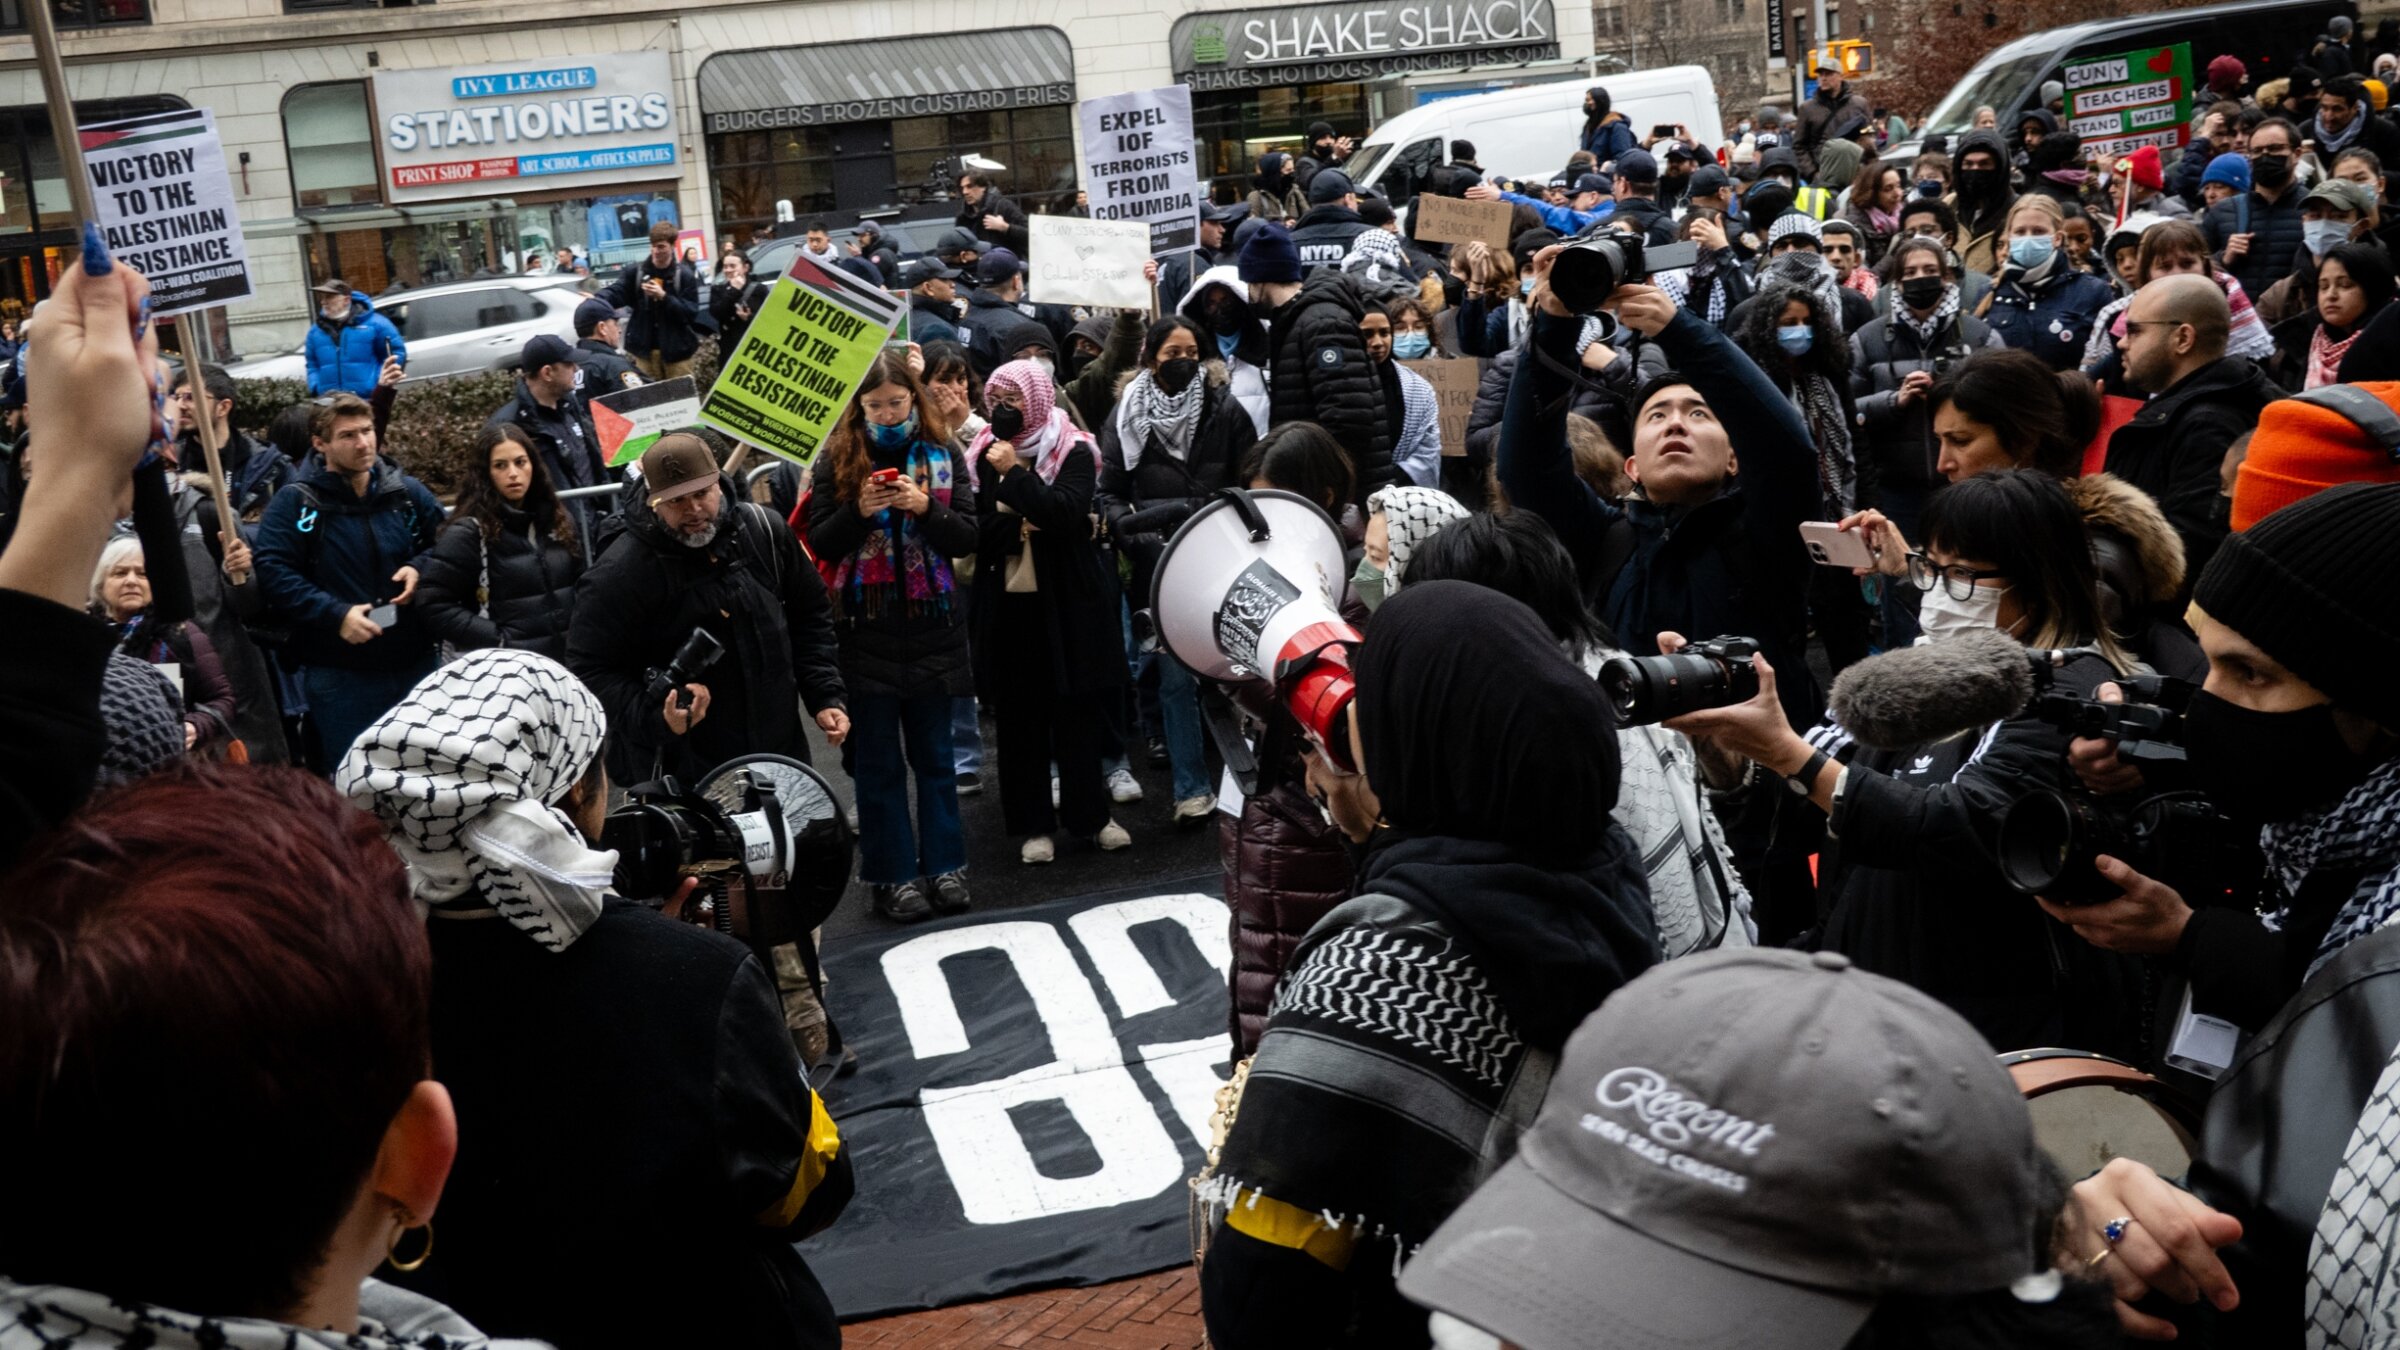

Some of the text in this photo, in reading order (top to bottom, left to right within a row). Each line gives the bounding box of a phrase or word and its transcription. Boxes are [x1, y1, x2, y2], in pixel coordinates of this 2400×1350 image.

[1243, 0, 1546, 61] SHAKE SHACK
[460, 70, 591, 96] IVY LEAGUE
[1184, 45, 1557, 91] SHAKES HOT DOGS CONCRETES SODA
[2067, 65, 2124, 83] CUNY
[715, 85, 1071, 132] BURGERS FROZEN CUSTARD FRIES
[2081, 85, 2167, 108] TEACHERS
[389, 93, 669, 150] STATIONERS
[1100, 107, 1166, 132] EXPEL
[2072, 108, 2173, 134] STAND WITH
[1117, 132, 1153, 153] IOF
[89, 147, 196, 188] VICTORY
[398, 164, 474, 184] PRINT SHOP
[542, 156, 580, 171] SCHOOL
[592, 152, 625, 166] OFFICE
[626, 148, 670, 163] SUPPLIES
[1091, 151, 1189, 178] TERRORISTS
[112, 181, 197, 217] TO THE
[1107, 173, 1170, 198] FROM
[1095, 193, 1193, 221] COLUMBIA
[102, 207, 228, 251] ALESTINIAN
[1300, 244, 1344, 261] NYPD
[150, 264, 244, 293] NTI-WAR COALITION
[787, 287, 868, 342] VICTORY
[783, 325, 840, 367] TO THE
[742, 337, 848, 402] PALESTINIAN
[729, 363, 831, 426] RESISTANCE
[708, 403, 809, 457] WORKERS WORLD PARTY
[761, 416, 815, 448] WORKERS.ORG
[1245, 572, 1278, 599] GLOBALIZE
[746, 841, 774, 864] RESIST.
[1595, 1066, 1776, 1155] Regent
[1668, 1154, 1747, 1192] CRUISES
